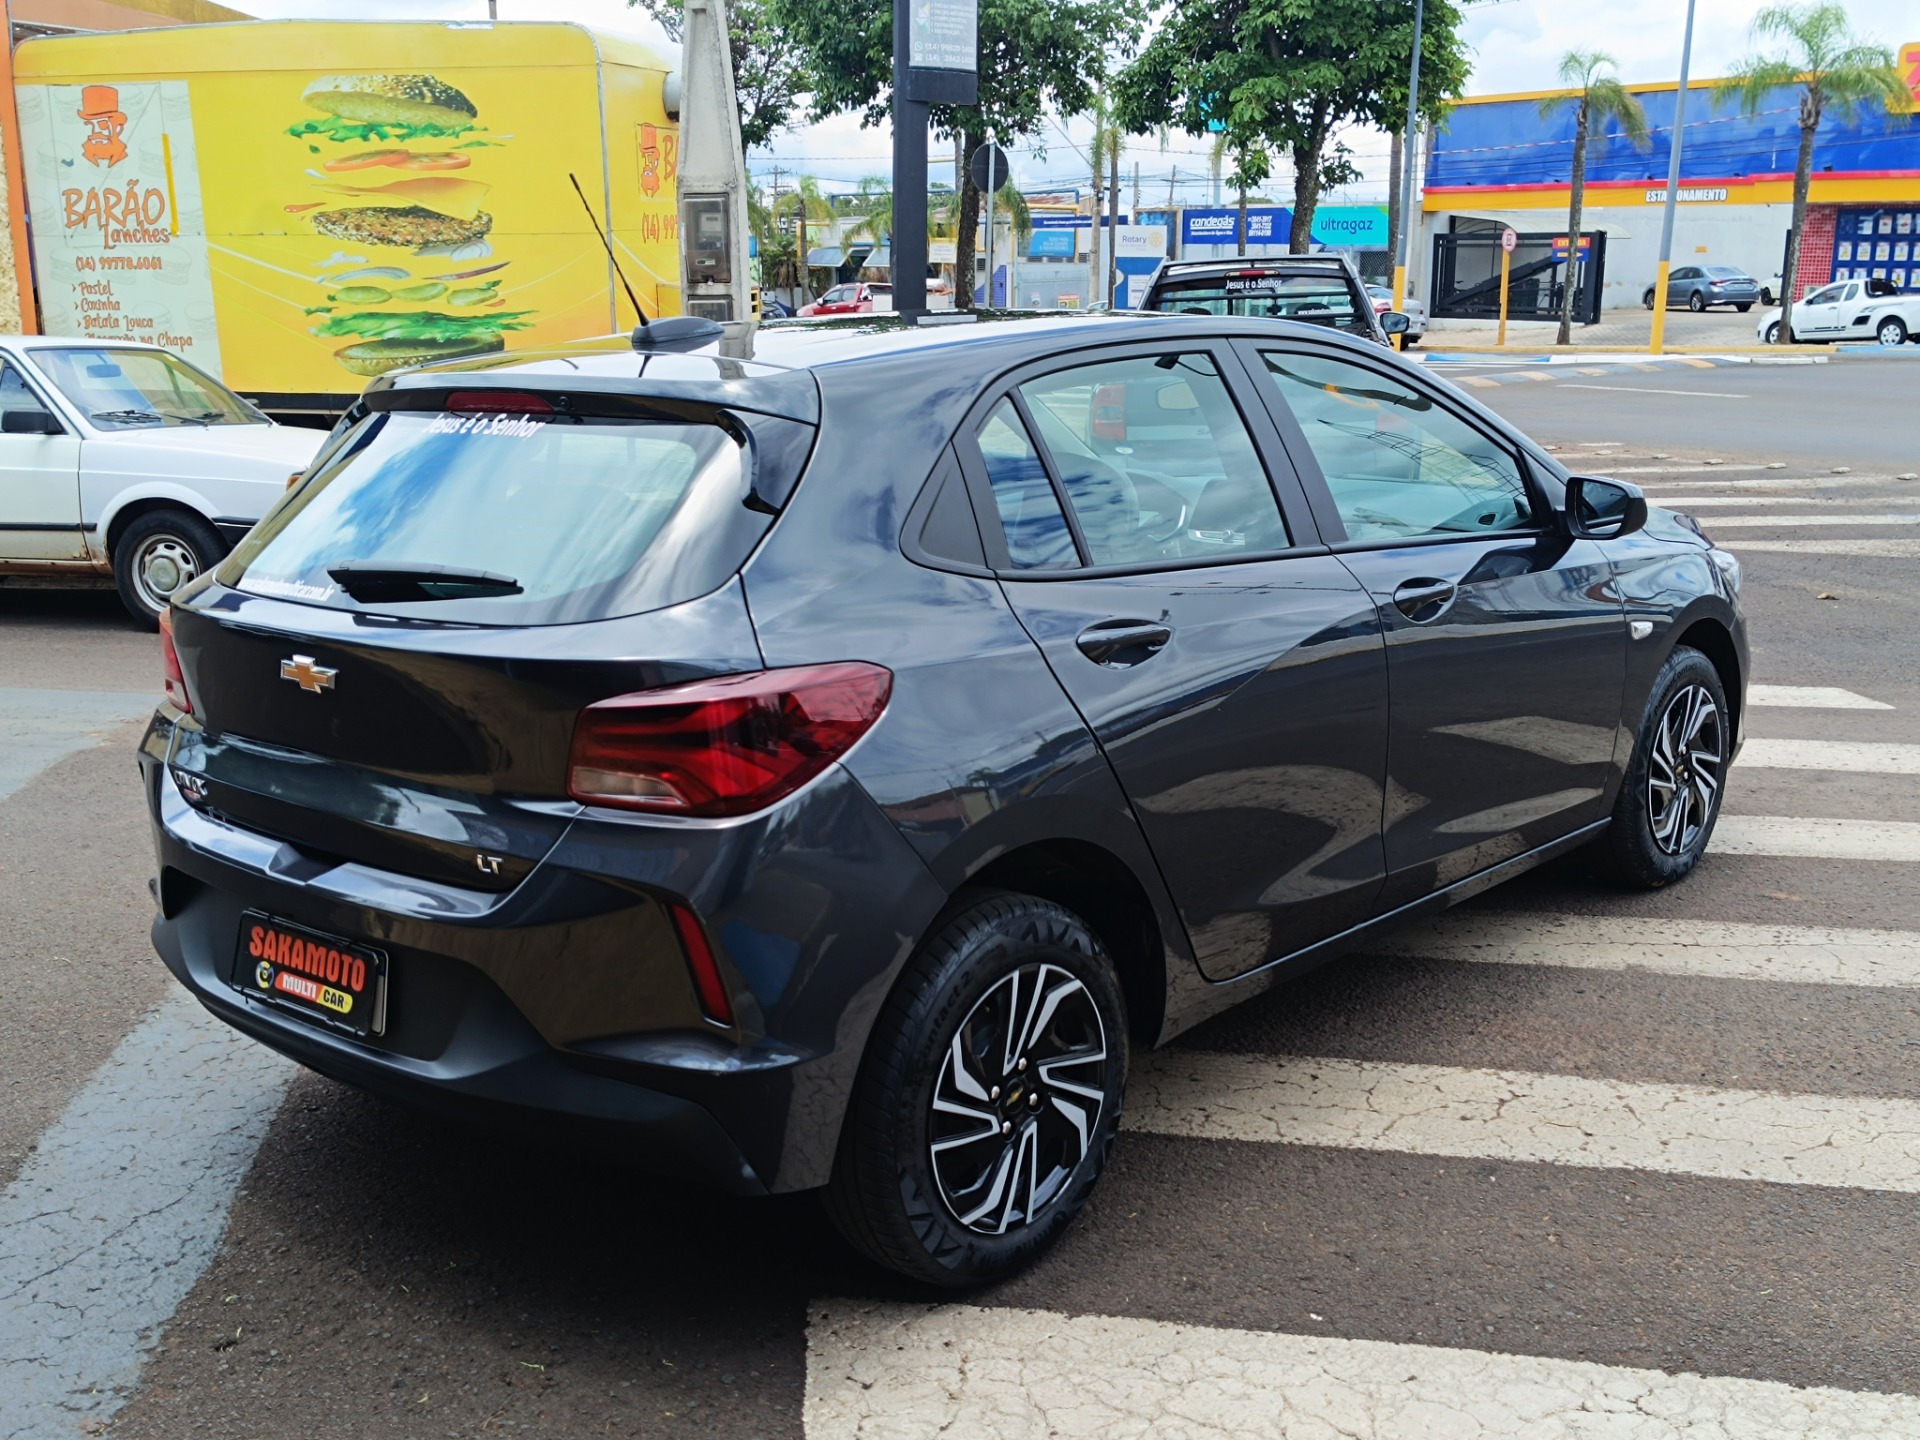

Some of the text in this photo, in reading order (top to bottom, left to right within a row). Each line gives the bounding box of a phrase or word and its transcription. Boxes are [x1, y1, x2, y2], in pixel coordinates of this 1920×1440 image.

[62, 179, 165, 229] BARÃO
[1646, 188, 1727, 202] ESTAONAMENTO
[1190, 214, 1235, 227] condegás
[1320, 217, 1373, 234] ultragaz
[99, 220, 170, 249] Lanches
[1122, 235, 1147, 244] Rotary
[75, 256, 97, 272] (14)
[79, 280, 114, 296] Pastel
[1225, 278, 1283, 290] Jesus é o Senhor
[80, 296, 121, 312] Coxinha
[83, 313, 154, 332] Batata Louca
[157, 331, 193, 352] Chapa
[422, 411, 547, 438] Jesus é o Senhor
[476, 853, 503, 875] LT
[249, 925, 366, 992] SAKAMOTO
[282, 974, 346, 1009] MULTI CAR
